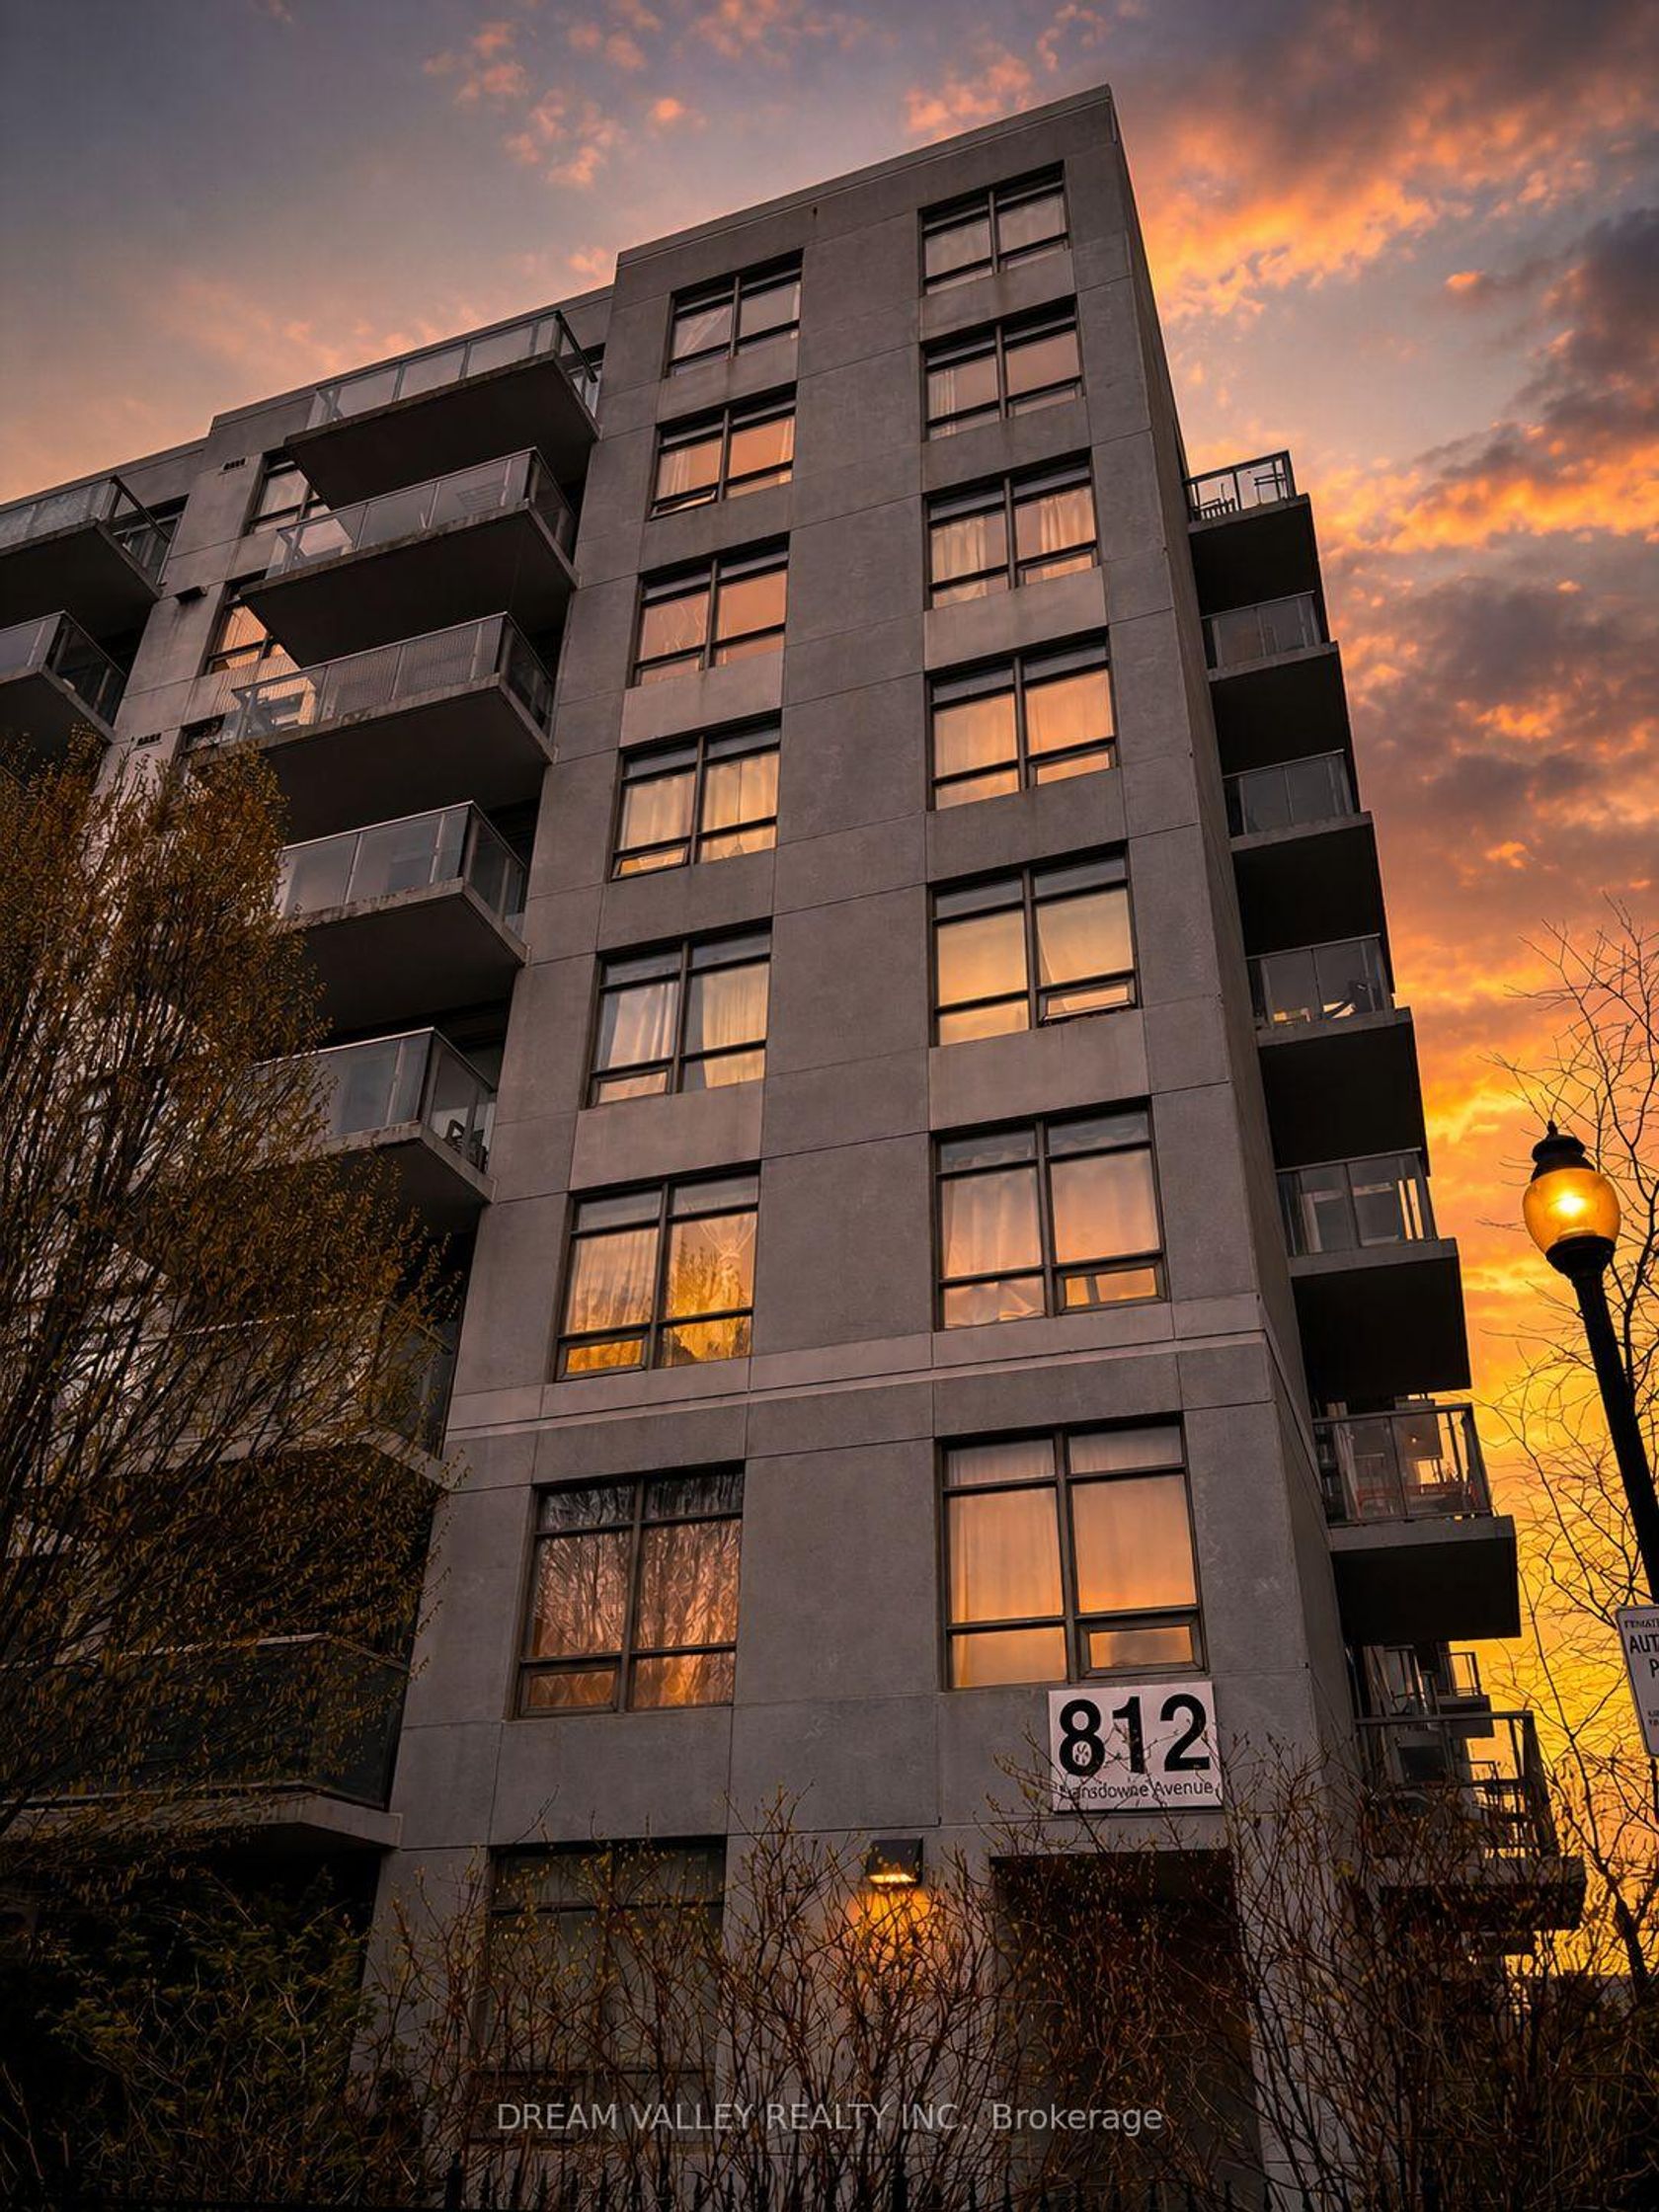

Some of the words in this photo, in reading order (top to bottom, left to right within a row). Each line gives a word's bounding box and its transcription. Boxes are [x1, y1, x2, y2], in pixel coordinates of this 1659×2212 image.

[1059, 1694, 1211, 1778] 812
[1060, 1782, 1148, 1799] ansdowne
[1155, 1780, 1214, 1797] Avenue
